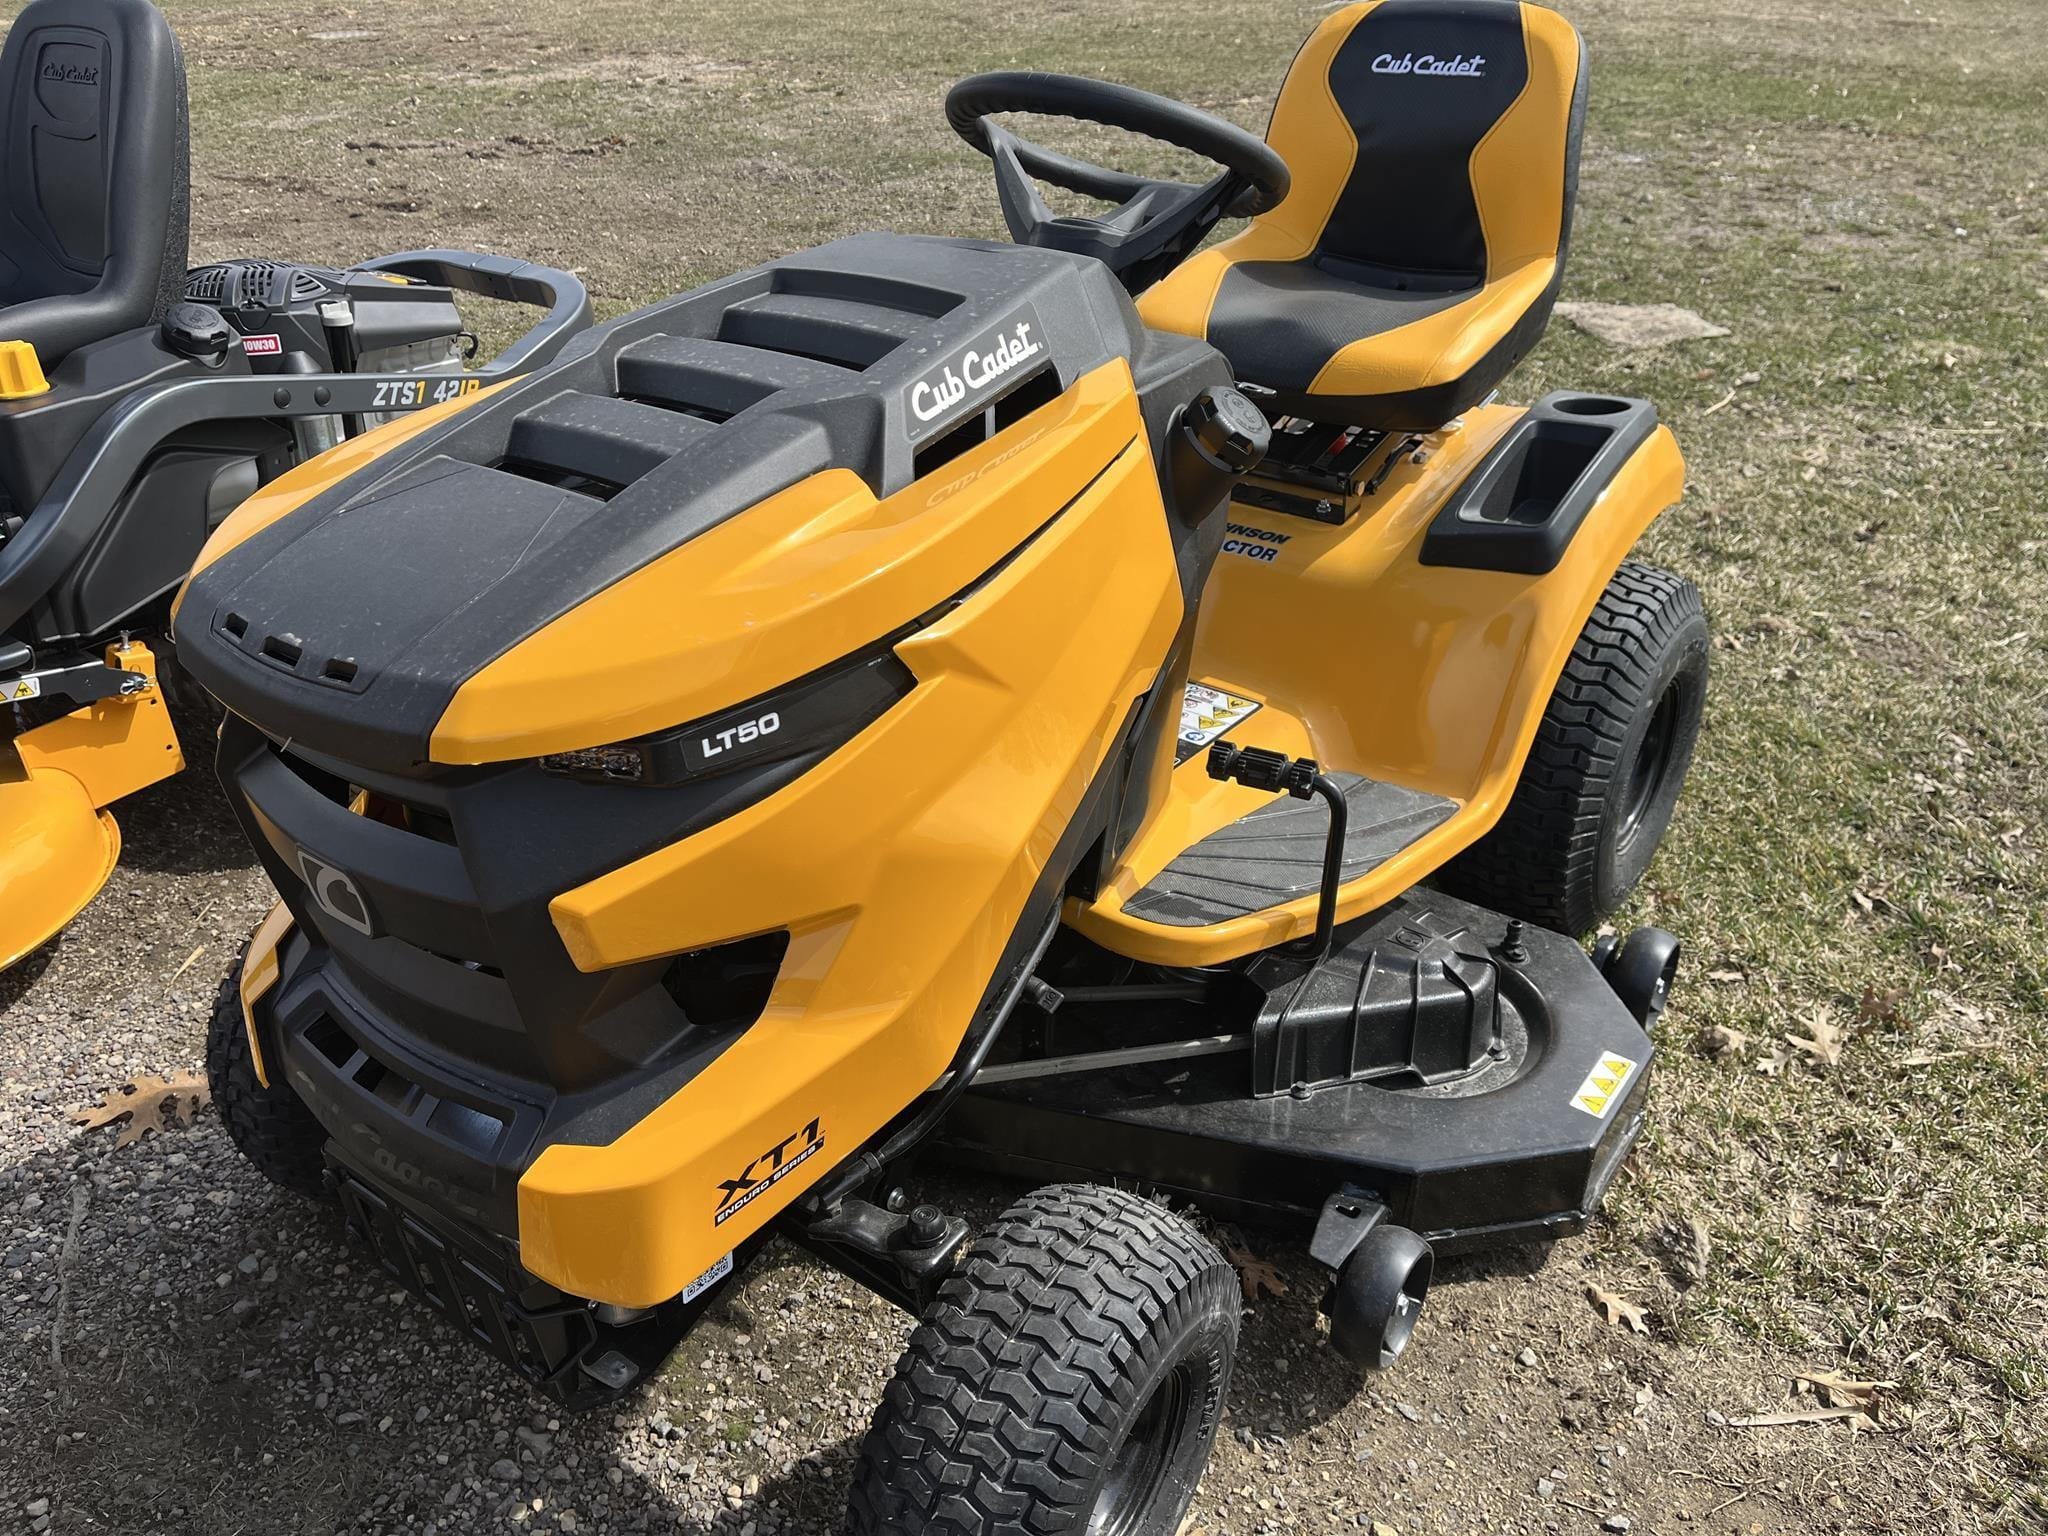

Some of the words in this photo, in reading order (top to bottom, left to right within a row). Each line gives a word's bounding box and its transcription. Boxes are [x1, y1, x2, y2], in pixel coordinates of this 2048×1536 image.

[1371, 53, 1413, 74] Cub
[1413, 55, 1486, 77] Cadet
[911, 366, 966, 421] Cub
[962, 322, 1039, 390] Cadet
[372, 380, 426, 406] ZTS1
[1222, 540, 1279, 561] CTOR
[1226, 522, 1293, 545] HNSON
[701, 711, 780, 758] LT50
[715, 1116, 820, 1213] XT1
[717, 1180, 770, 1223] ENDURO
[773, 1144, 817, 1181] SERIES
